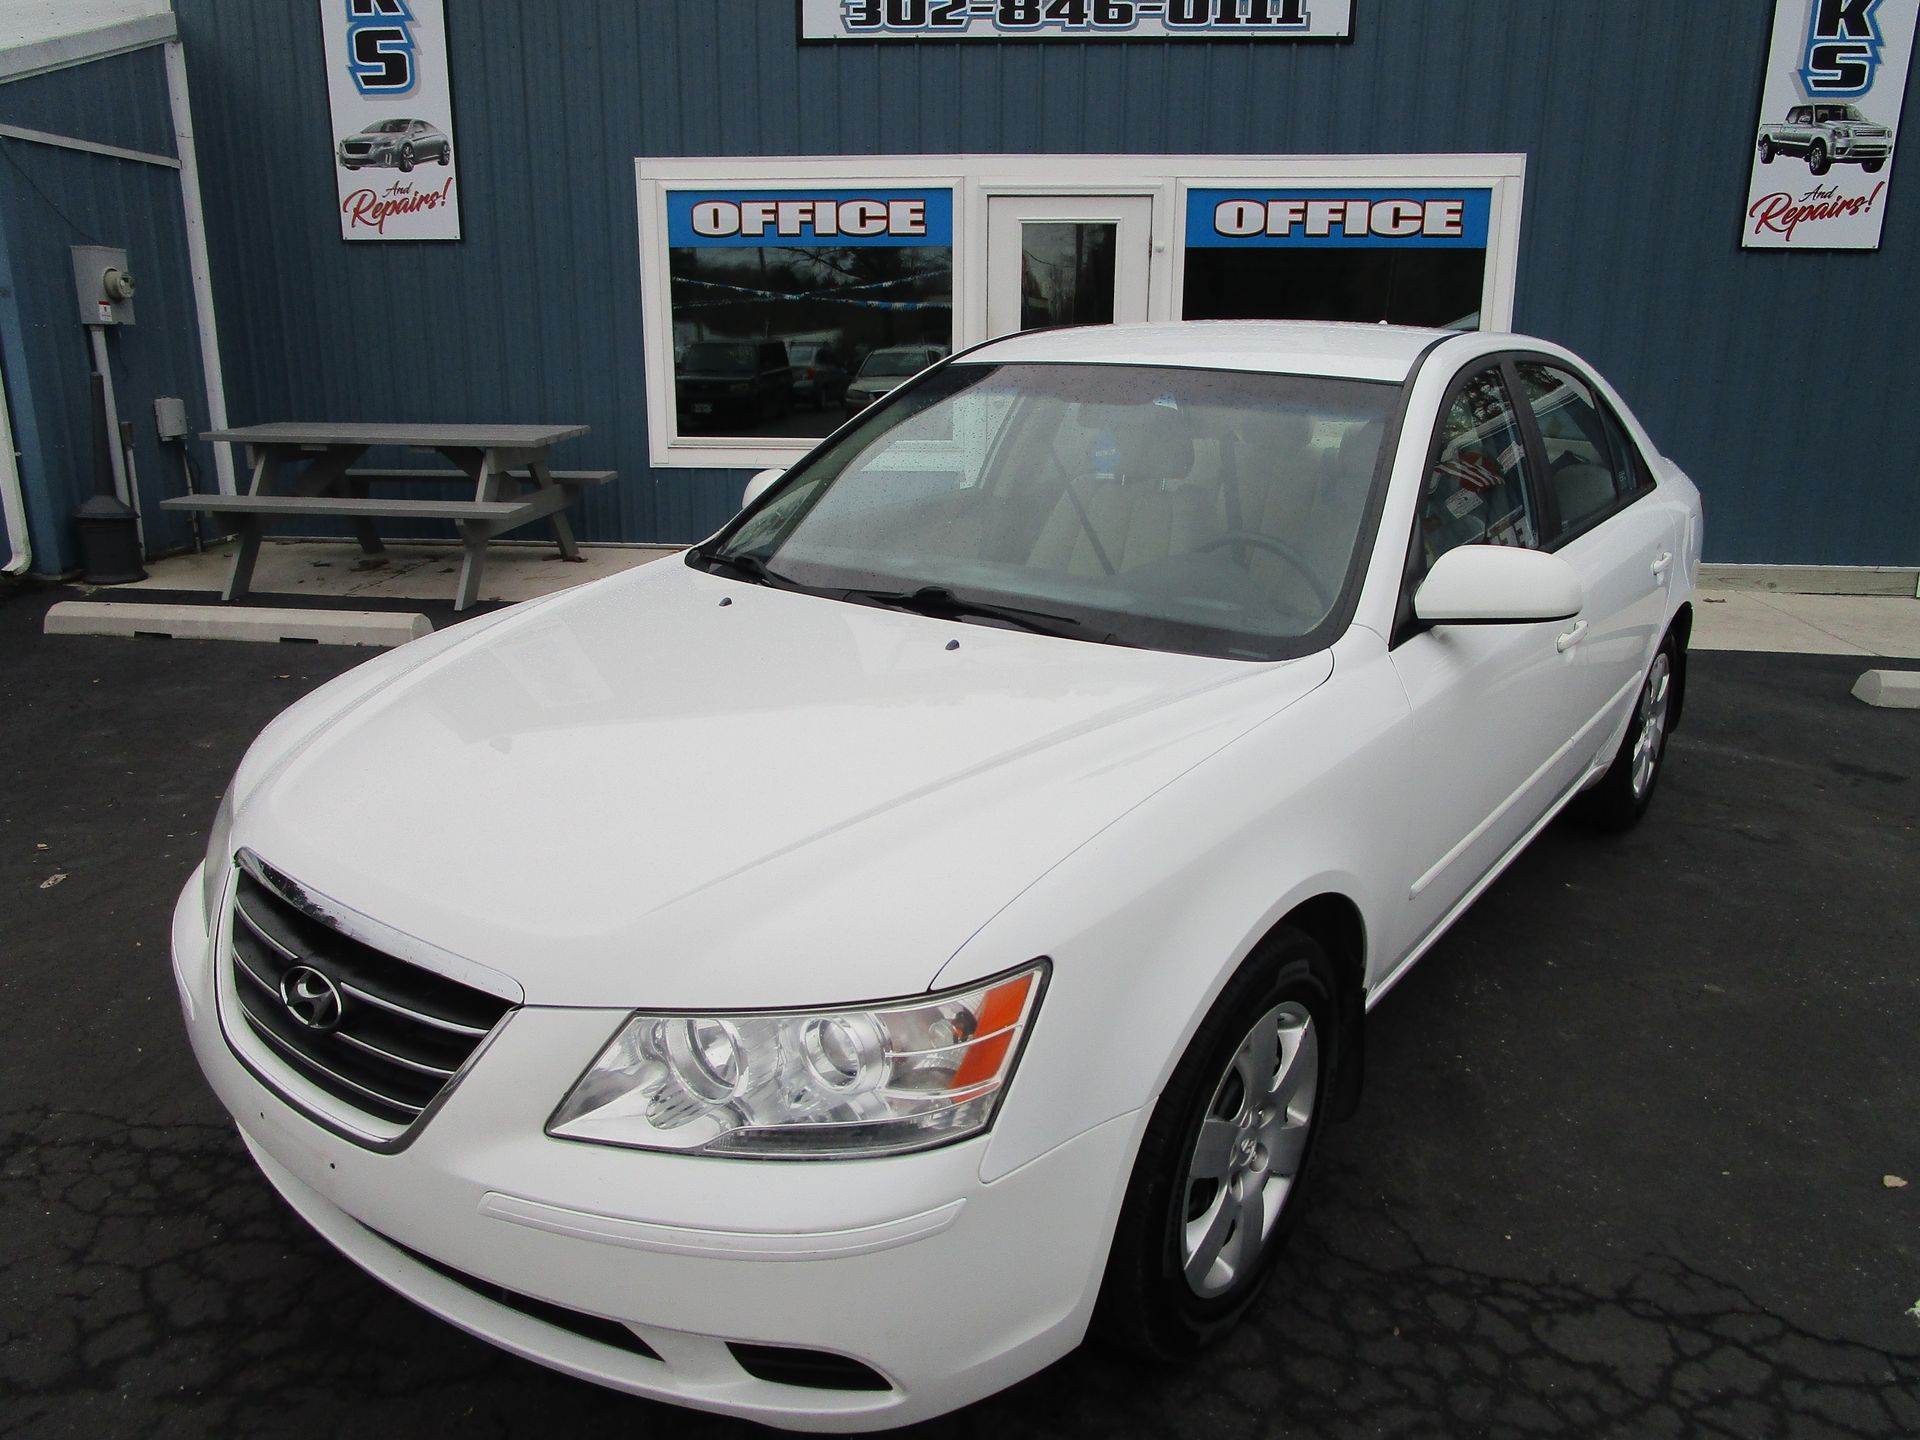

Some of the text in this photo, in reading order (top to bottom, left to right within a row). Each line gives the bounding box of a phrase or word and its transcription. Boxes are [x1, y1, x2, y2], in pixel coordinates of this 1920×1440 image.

[342, 177, 453, 234] Repairs!
[382, 180, 414, 198] And
[1798, 184, 1839, 202] And
[692, 199, 928, 238] OFFICE
[1213, 198, 1464, 238] OFFICE
[1749, 181, 1885, 242] Repairs!
